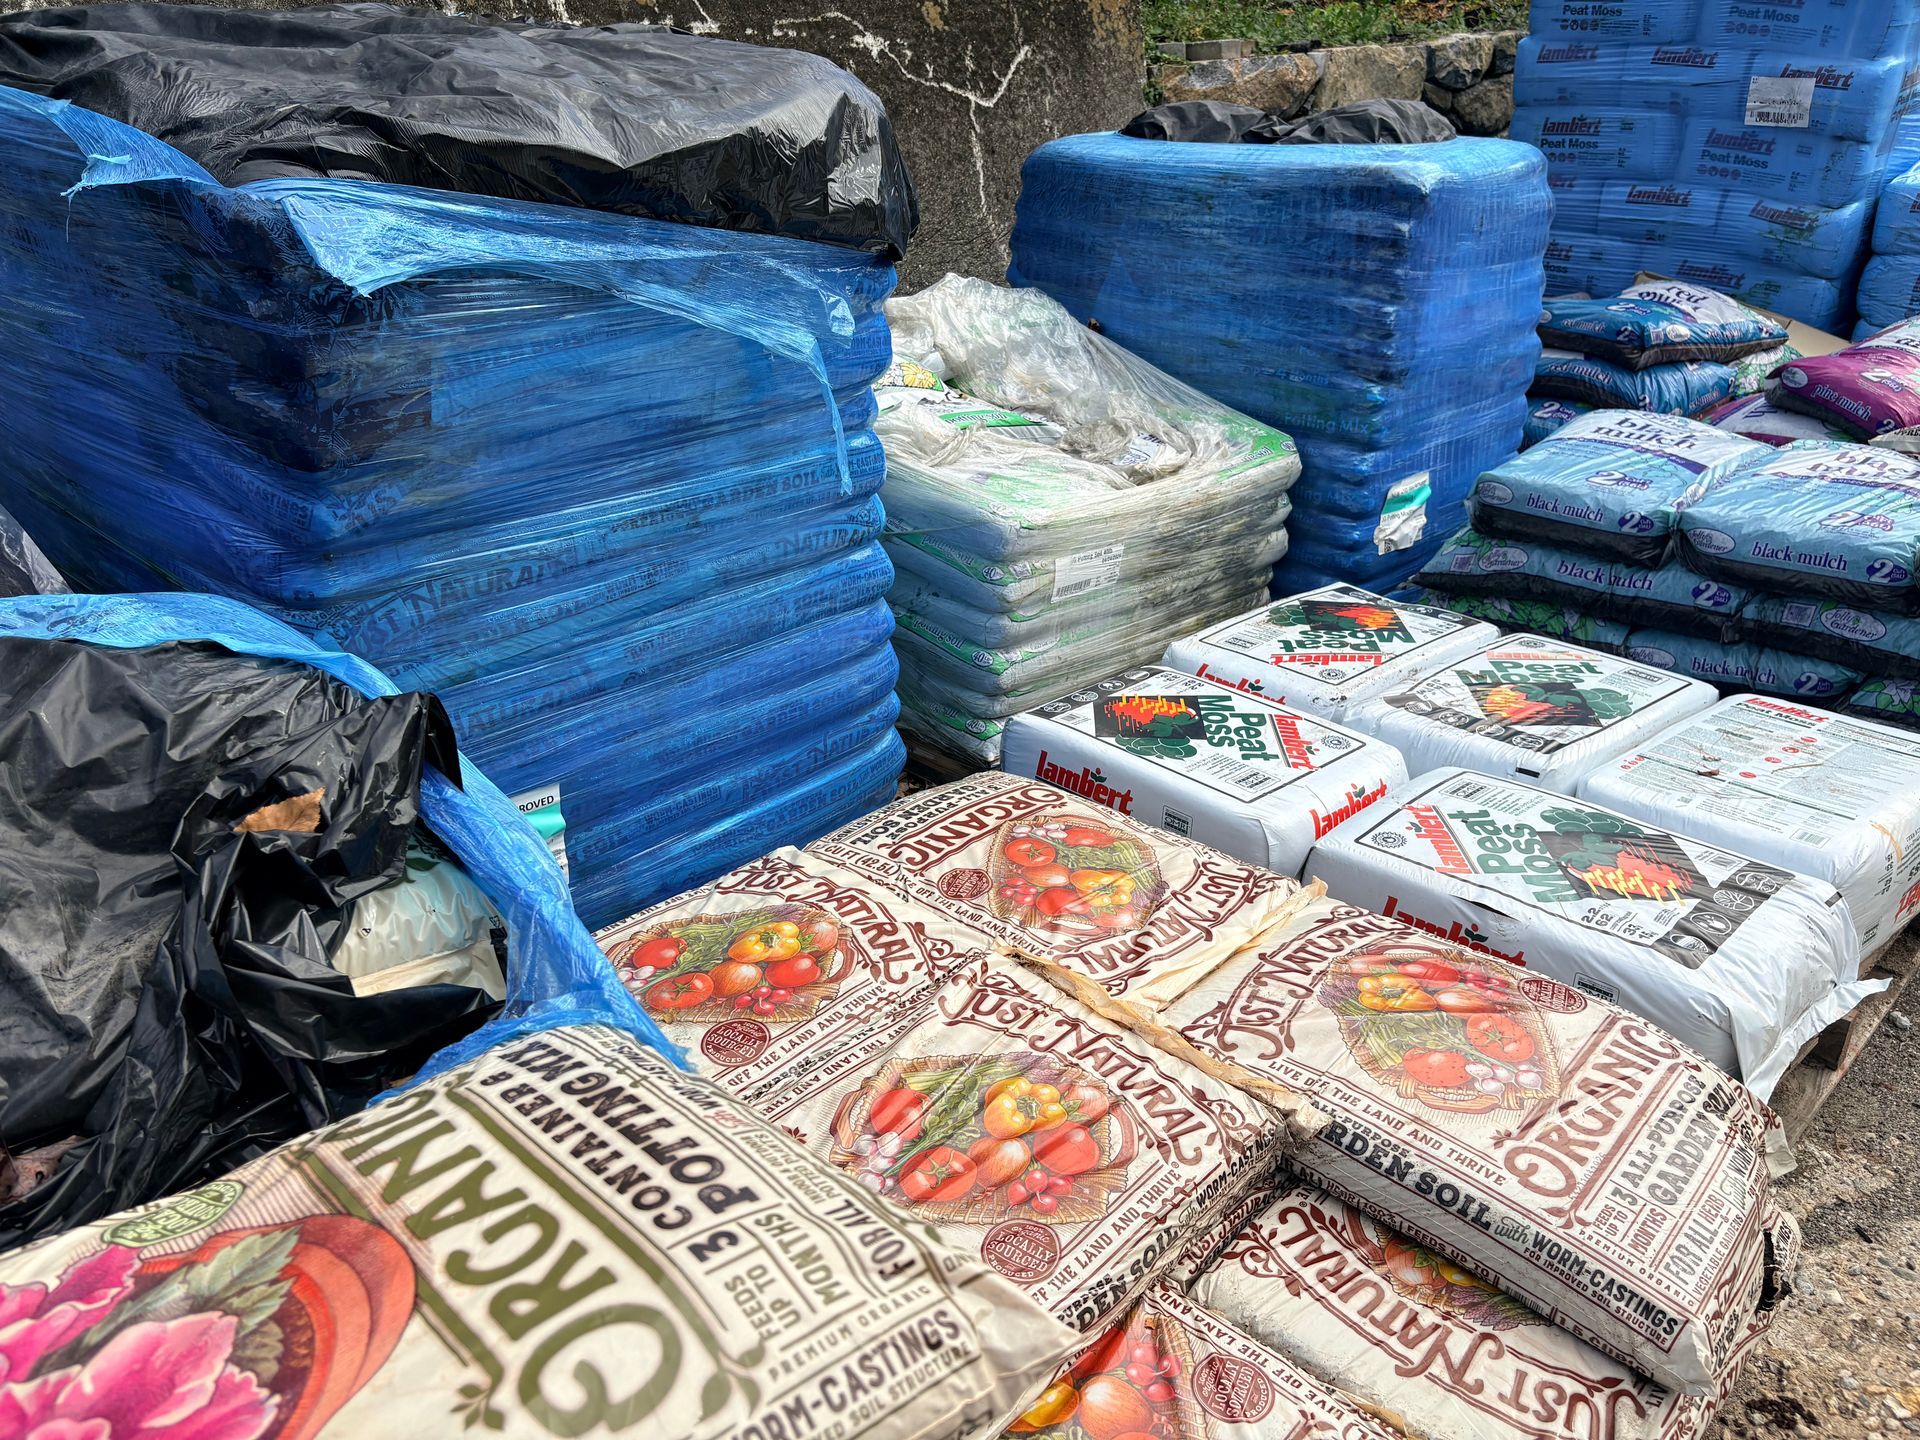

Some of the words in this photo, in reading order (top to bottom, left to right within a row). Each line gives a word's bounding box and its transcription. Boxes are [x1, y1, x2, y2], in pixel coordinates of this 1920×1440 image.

[1563, 5, 1589, 16] Peat
[1592, 5, 1622, 17] Moss
[1763, 8, 1800, 23] Moss
[1541, 138, 1566, 149] Peat
[1568, 138, 1599, 150] Moss
[1733, 154, 1769, 169] Moss
[1811, 384, 1838, 401] pine
[1835, 397, 1872, 421] mulch
[782, 471, 820, 492] SOIL
[1527, 493, 1561, 513] black
[1562, 504, 1604, 522] mulch
[1557, 560, 1604, 583] black
[1752, 541, 1793, 562] black
[1797, 548, 1848, 571] mulch
[947, 632, 966, 650] soil
[1279, 639, 1381, 652] Peat
[1298, 629, 1417, 643] Moss
[1831, 620, 1878, 639] Gardener
[973, 652, 985, 664] 40
[1269, 653, 1383, 667] lambert
[1454, 669, 1586, 685] Moss
[1489, 660, 1604, 675] Peat
[1692, 657, 1730, 674] black
[1198, 694, 1235, 748] Moss
[1734, 702, 1773, 716] Peat
[1776, 713, 1818, 727] Moss
[1230, 711, 1281, 762] Peat
[1272, 713, 1322, 771] lambert
[1035, 749, 1134, 815] lambert
[885, 788, 990, 840] ALL-PURPOSE
[900, 784, 979, 821] GARDEN
[1308, 778, 1389, 840] lambert
[851, 818, 900, 847] SOIL
[888, 786, 1067, 868] ORGANIC
[1406, 803, 1474, 875] lambert
[1446, 808, 1514, 875] Peat
[824, 843, 840, 854] CU
[840, 848, 854, 860] FT
[854, 854, 901, 877] (42.5L)
[1510, 822, 1582, 904] Moss
[1199, 860, 1255, 910] JUST
[715, 869, 803, 895] JUST
[785, 881, 920, 984] NATURAL
[916, 886, 935, 900] OFF
[934, 894, 954, 910] THE
[954, 904, 982, 923] LAND
[982, 920, 1008, 936] AND
[1006, 931, 1046, 958] THRIVE
[1054, 889, 1220, 975] NATURAL
[1596, 913, 1613, 927] 62
[1258, 913, 1418, 999] NATURAL
[707, 1034, 759, 1059] SOURCED
[714, 1026, 765, 1047] LOCALLY
[753, 1049, 783, 1075] THE
[782, 1025, 819, 1057] LAND
[817, 1007, 849, 1034] AND
[863, 1039, 887, 1055] THE
[889, 1024, 909, 1041] OFF
[499, 1039, 552, 1082] MIX
[704, 1047, 745, 1065] PRODUCED
[824, 1053, 860, 1075] LAND
[938, 973, 1048, 1028] JUST
[1028, 1018, 1209, 1166] NATURAL
[793, 1075, 821, 1096] AND
[1268, 1058, 1302, 1083] LIVE
[1304, 1074, 1331, 1097] OFF
[1332, 1086, 1361, 1109] THE
[1360, 1100, 1406, 1132] LAND
[1407, 1126, 1443, 1153] AND
[1446, 1147, 1507, 1188] THRIVE
[1311, 1100, 1410, 1158] ALL-PURPOSE
[1504, 1025, 1680, 1200] ORGANIC
[1620, 1074, 1708, 1189] ALL-PURPOSE
[498, 1082, 692, 1233] CONTAINER
[559, 1074, 761, 1217] POTTING
[1646, 1111, 1721, 1206] GARDEN
[1702, 1083, 1737, 1117] SOIL
[1610, 1187, 1639, 1206] 3
[1703, 1192, 1726, 1228] HERB
[823, 1196, 881, 1246] ALL
[1047, 1262, 1078, 1293] THE
[1074, 1231, 1114, 1269] LAND
[1112, 1206, 1140, 1238] AND
[1138, 1167, 1182, 1219] THRIVE
[1592, 1204, 1616, 1233] FEEDS
[1605, 1221, 1621, 1240] UP
[1614, 1210, 1630, 1227] TO
[1628, 1207, 1669, 1255] MONTHS
[686, 1229, 741, 1264] 3
[754, 1209, 854, 1306] MONTHS
[990, 1243, 1049, 1273] SOURCED
[995, 1230, 1054, 1259] LOCALLY
[1129, 1225, 1183, 1278] SOIL
[1178, 1231, 1215, 1275] JUST
[1405, 1225, 1447, 1252] FEEDS
[1449, 1249, 1468, 1263] UP
[1472, 1262, 1490, 1278] TO
[1414, 1170, 1494, 1232] SOIL
[1494, 1215, 1531, 1246] with
[1531, 1231, 1681, 1337] WORM-CASTINGS
[1692, 1219, 1719, 1259] ALL
[1692, 1244, 1729, 1296] VEGETABLE
[1721, 1214, 1744, 1250] GARDENS
[318, 1086, 683, 1438] ORGANIC
[746, 1264, 777, 1294] TO
[864, 1236, 916, 1284] FOR
[988, 1255, 1035, 1280] PRODUCED
[1578, 1228, 1636, 1268] PREMIUM
[1638, 1268, 1697, 1307] ORGANIC
[1664, 1249, 1699, 1288] FOR
[724, 1275, 781, 1340] FEEDS
[769, 1298, 800, 1329] UP
[1159, 1292, 1193, 1316] AND
[1278, 1205, 1504, 1392] NATURAL
[1523, 1246, 1545, 1263] FOR
[1542, 1257, 1591, 1294] IMPROVED
[1588, 1288, 1613, 1310] SOIL
[1613, 1306, 1670, 1346] STRUCTURE
[766, 1324, 854, 1384] PREMIUM
[856, 1284, 932, 1331] ORGANIC
[1194, 1314, 1238, 1347] LAND
[1237, 1343, 1270, 1367] THE
[848, 1394, 891, 1432] SOIL
[884, 1342, 972, 1402] STRUCTURE
[1202, 1361, 1224, 1397] organic
[1211, 1360, 1241, 1412] LOCALLY
[1226, 1366, 1255, 1418] SOURCED
[1244, 1377, 1268, 1418] PRODUCED
[1272, 1367, 1303, 1390] OFF
[1304, 1389, 1346, 1421] LIVE
